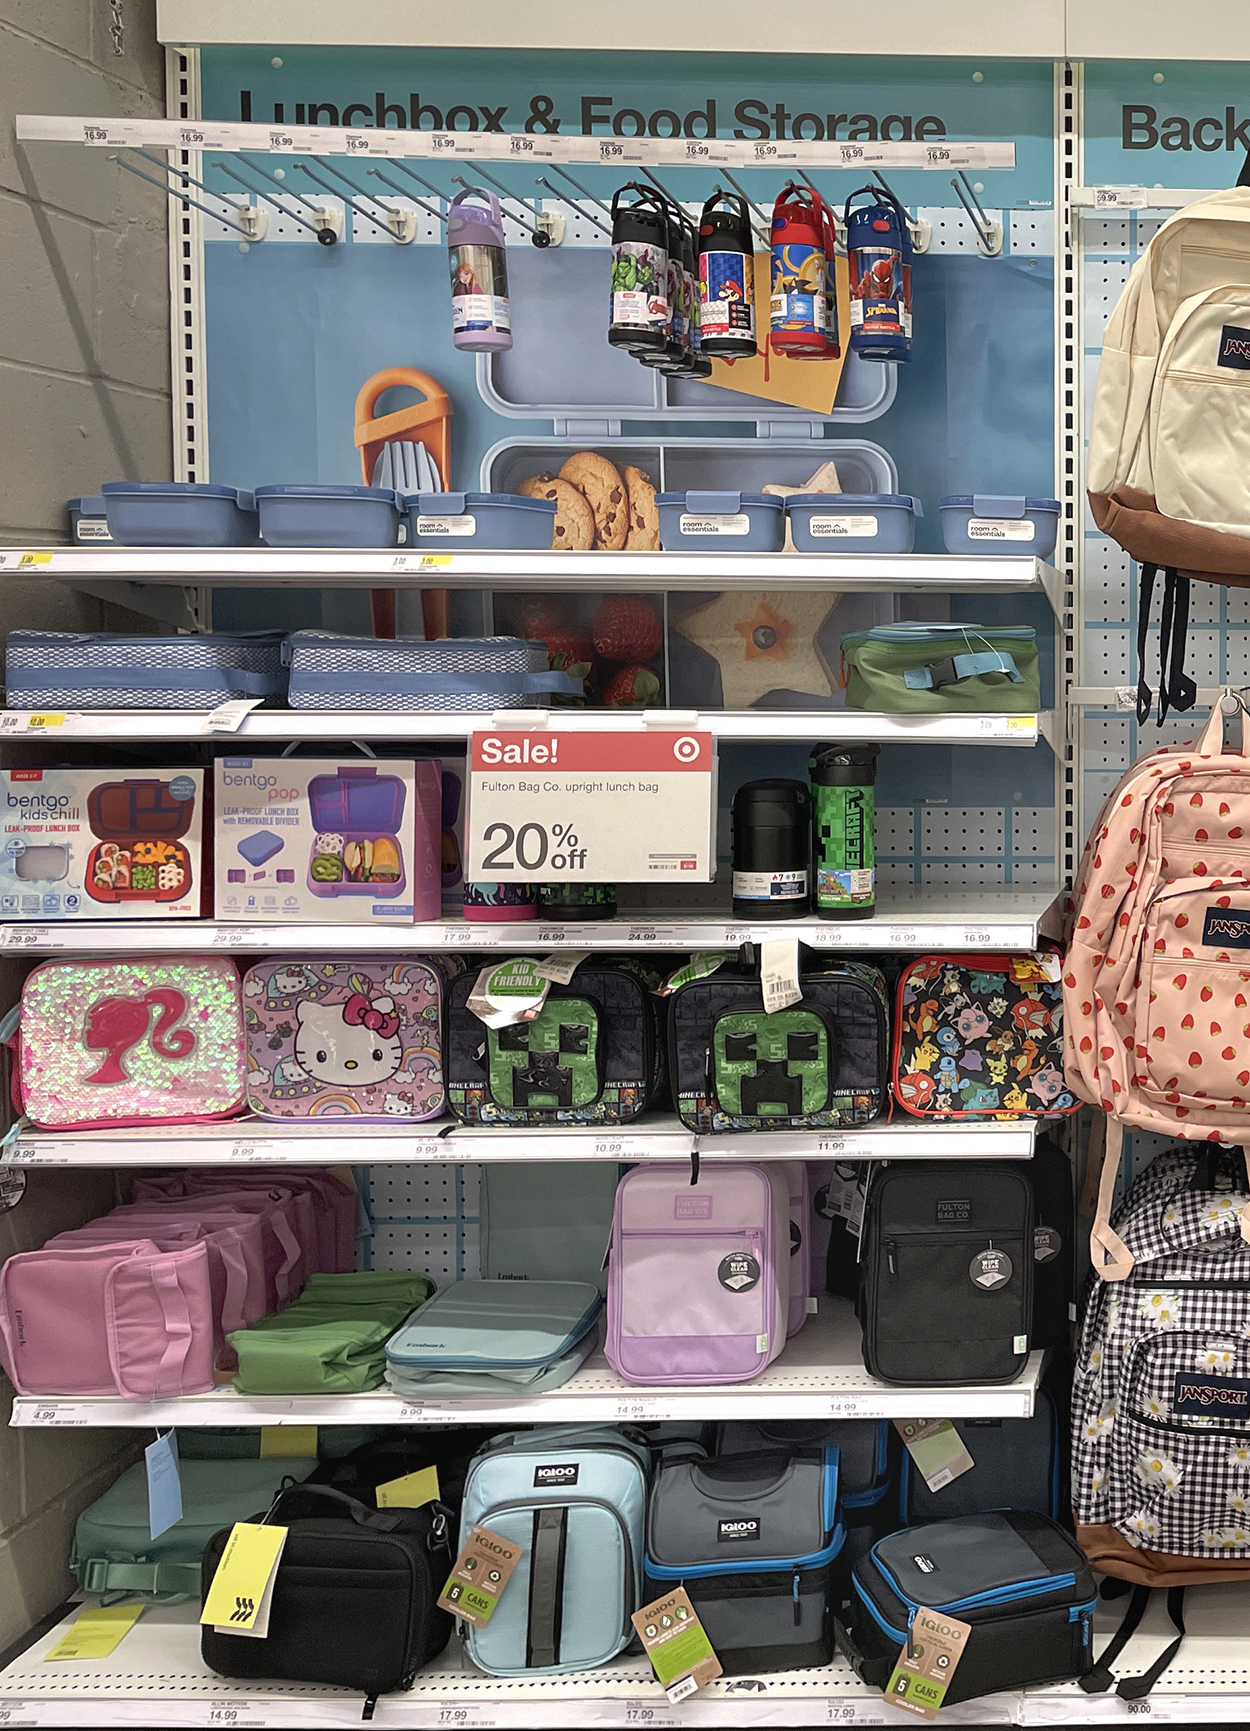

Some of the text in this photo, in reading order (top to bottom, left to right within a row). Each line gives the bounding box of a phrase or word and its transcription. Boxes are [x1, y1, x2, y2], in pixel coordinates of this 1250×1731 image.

[241, 90, 947, 141] Lunchbox & Food Storage
[84, 131, 107, 140] 16.99
[180, 133, 204, 142] 16.99
[270, 137, 293, 146] 16.99
[346, 140, 369, 149] 16.99
[432, 139, 455, 148] 16.99
[510, 141, 534, 151] 16.99
[600, 146, 623, 156] 16.99
[686, 146, 709, 155] 16.99
[754, 146, 777, 155] 16.99
[841, 149, 863, 159] 16.99
[927, 151, 950, 160] 16.99
[481, 738, 558, 764] Sale!
[223, 771, 277, 790] bentgo
[481, 781, 659, 794] Fulton Bag Co. upright lunch bag
[268, 788, 299, 803] pop
[7, 792, 69, 811] bentgo
[20, 807, 80, 821] kids chill
[223, 807, 299, 816] LEAK-PROOF LUNCH BOX
[223, 817, 300, 826] with REMOVABLE DIVIDER
[5, 824, 80, 833] LEAK-PROOF LUNCH BOX
[481, 822, 578, 871] 20 %
[550, 849, 588, 870] off
[8, 935, 37, 944] 29.99
[213, 935, 242, 943] 29.99
[443, 933, 471, 941] 17.99
[537, 933, 565, 941] 16.99
[628, 933, 656, 941] 24.99
[724, 934, 751, 942] 19.99
[815, 934, 842, 942] 18.99
[890, 934, 916, 942] 16.99
[964, 934, 991, 942] 16.99
[511, 963, 530, 975] KID
[494, 974, 543, 987] FRIENDLY
[416, 1146, 438, 1154] 9.99
[594, 1144, 622, 1152] 10.99
[818, 1142, 845, 1150] 11.99
[13, 1150, 36, 1158] 9.99
[231, 1148, 254, 1156] 9.99
[938, 1203, 970, 1211] FULTON
[938, 1211, 969, 1219] BAG CO
[1177, 1384, 1248, 1406] JANSPORT
[616, 1405, 644, 1414] 14.99
[829, 1403, 857, 1412] 14.99
[33, 1410, 56, 1420] 4.99
[400, 1408, 423, 1418] 9.99
[538, 1467, 576, 1477] IGLOO
[721, 1521, 757, 1532] IGLOO
[475, 1535, 513, 1560] IGLOO
[467, 1592, 489, 1610] CANS
[645, 1598, 676, 1620] IGLOO
[921, 1617, 962, 1640] IGLOO
[897, 1680, 938, 1700] 5 CANS
[895, 1698, 915, 1711] COOLER
[828, 1708, 855, 1718] 17.99
[1127, 1705, 1151, 1714] 90.00
[209, 1710, 237, 1721] 14.99
[439, 1711, 467, 1721] 17.99
[626, 1710, 654, 1720] 17.99
